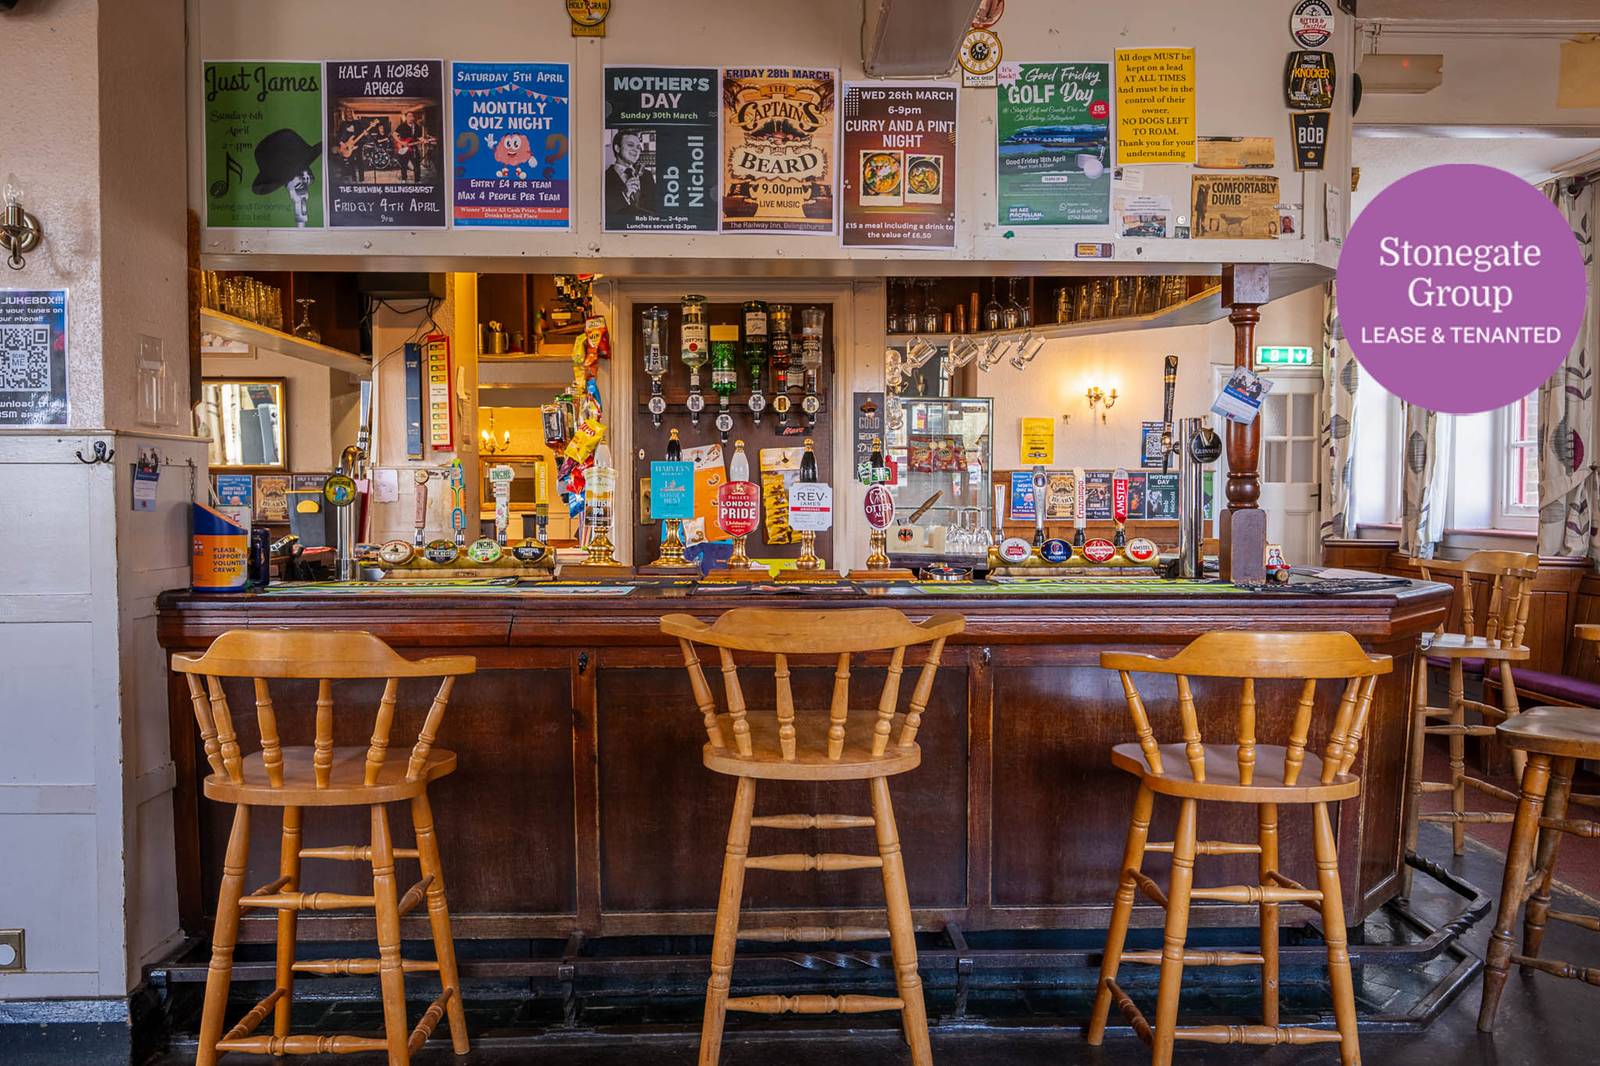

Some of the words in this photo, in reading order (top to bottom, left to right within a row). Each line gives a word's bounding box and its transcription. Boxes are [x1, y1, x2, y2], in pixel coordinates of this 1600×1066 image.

[1132, 54, 1151, 63] dogs
[339, 65, 368, 79] HALF
[374, 66, 382, 78] A
[387, 64, 429, 78] HORSE
[1126, 64, 1145, 73] kept
[1295, 68, 1329, 78] KNOCKER
[457, 72, 508, 82] SATURDAY
[537, 72, 565, 83] APRIL
[726, 69, 764, 79] FRIDAY
[767, 69, 790, 79] 28th
[793, 69, 831, 80] MARCH
[1025, 67, 1058, 82] Good
[1061, 67, 1101, 86] Friday
[1124, 75, 1135, 83] AT
[1138, 74, 1156, 82] ALL
[1158, 74, 1186, 83] TIMES
[204, 66, 251, 101] Just
[253, 66, 319, 101] James
[364, 82, 404, 95] APIECE
[613, 77, 710, 92] MOTHER'S
[768, 85, 788, 94] THE
[1008, 84, 1055, 104] GOLF
[1060, 82, 1094, 107] Day
[641, 93, 682, 109] DAY
[861, 91, 886, 100] WED
[888, 91, 913, 100] 26th
[915, 91, 954, 101] MARCH
[473, 101, 547, 115] MONTHLY
[888, 106, 922, 116] 6-9pm
[621, 111, 651, 121] Sunday
[653, 112, 671, 120] 30th
[673, 112, 699, 120] March
[738, 99, 822, 132] CAPTAIN'S
[1122, 117, 1137, 125] NO
[1139, 117, 1165, 125] DOGS
[1167, 117, 1189, 125] LEFT
[468, 117, 504, 130] QUIZ
[508, 116, 553, 130] NIGHT
[845, 120, 885, 133] CURRY
[888, 120, 914, 133] AND
[916, 121, 925, 133] A
[928, 121, 955, 133] PINT
[224, 126, 249, 137] April
[1132, 128, 1146, 136] TO
[1148, 128, 1179, 136] ROAM.
[1299, 127, 1324, 144] BOB
[883, 134, 923, 148] NIGHT
[1118, 139, 1143, 147] Thank
[1145, 140, 1160, 149] you
[1162, 138, 1173, 146] for
[1174, 140, 1195, 148] your
[1126, 150, 1186, 159] understanding
[739, 151, 819, 175] BEARD
[1021, 157, 1039, 166] Friday
[688, 136, 705, 207] Nicholl
[339, 185, 352, 193] THE
[470, 179, 495, 188] ENTRY
[499, 179, 510, 188] £4
[663, 166, 680, 207] Rob
[1212, 182, 1277, 194] COMFORTABLY
[761, 184, 803, 196] 9.00pm
[458, 191, 476, 200] MAX
[479, 191, 485, 200] 4
[488, 192, 517, 201] PEOPLE
[520, 192, 535, 201] PER
[539, 192, 560, 201] TEAM
[1212, 194, 1241, 205] DUMB
[335, 199, 374, 213] FRIDAY
[380, 199, 404, 212] 4TH
[410, 199, 440, 212] APRIL
[759, 200, 774, 208] LIVE
[776, 200, 801, 209] MUSIC
[743, 222, 769, 230] Railway
[884, 222, 918, 231] including
[925, 223, 945, 231] drink
[1117, 481, 1125, 515] AMSTEL
[721, 508, 756, 519] PRIDE
[866, 506, 892, 514] OTTER
